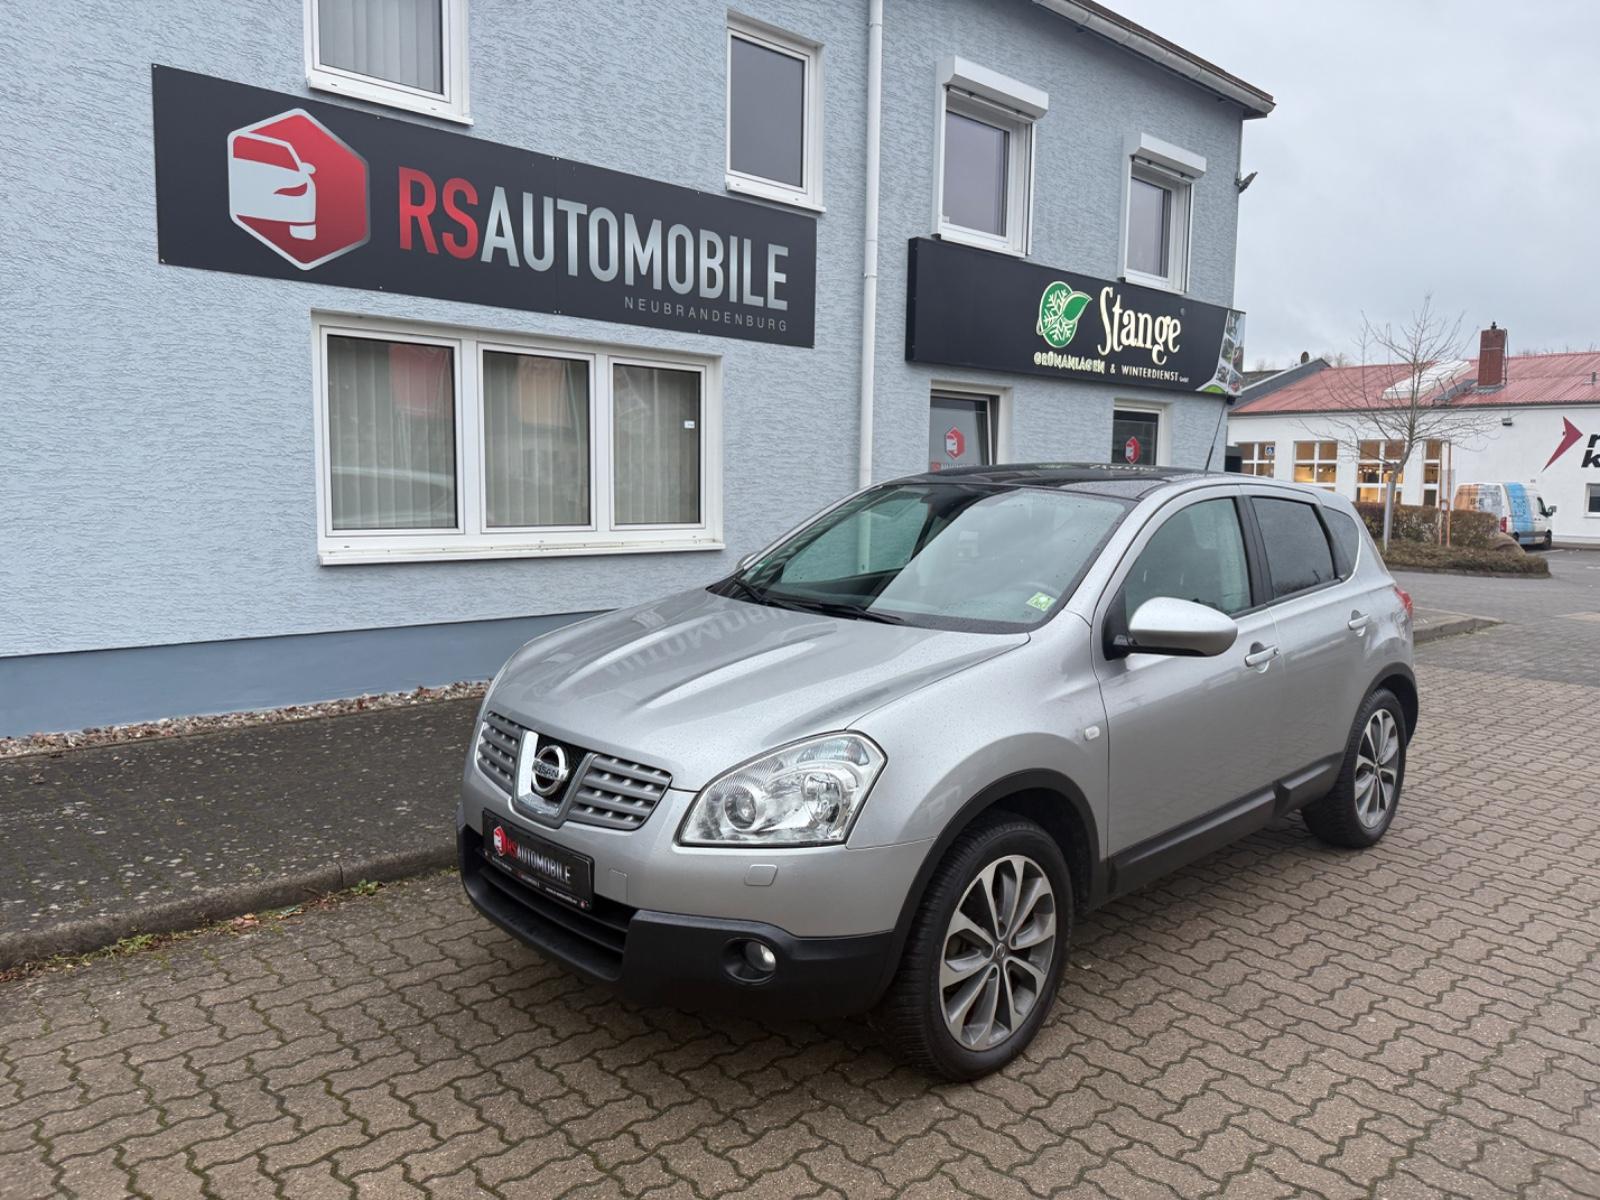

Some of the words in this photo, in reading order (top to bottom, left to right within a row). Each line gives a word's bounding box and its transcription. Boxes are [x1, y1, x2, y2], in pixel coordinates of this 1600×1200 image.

[624, 296, 787, 332] NEUBRANDENBURG
[1097, 286, 1181, 366] Stange
[1110, 364, 1116, 374] &
[1121, 365, 1179, 382] WINTERDIENST
